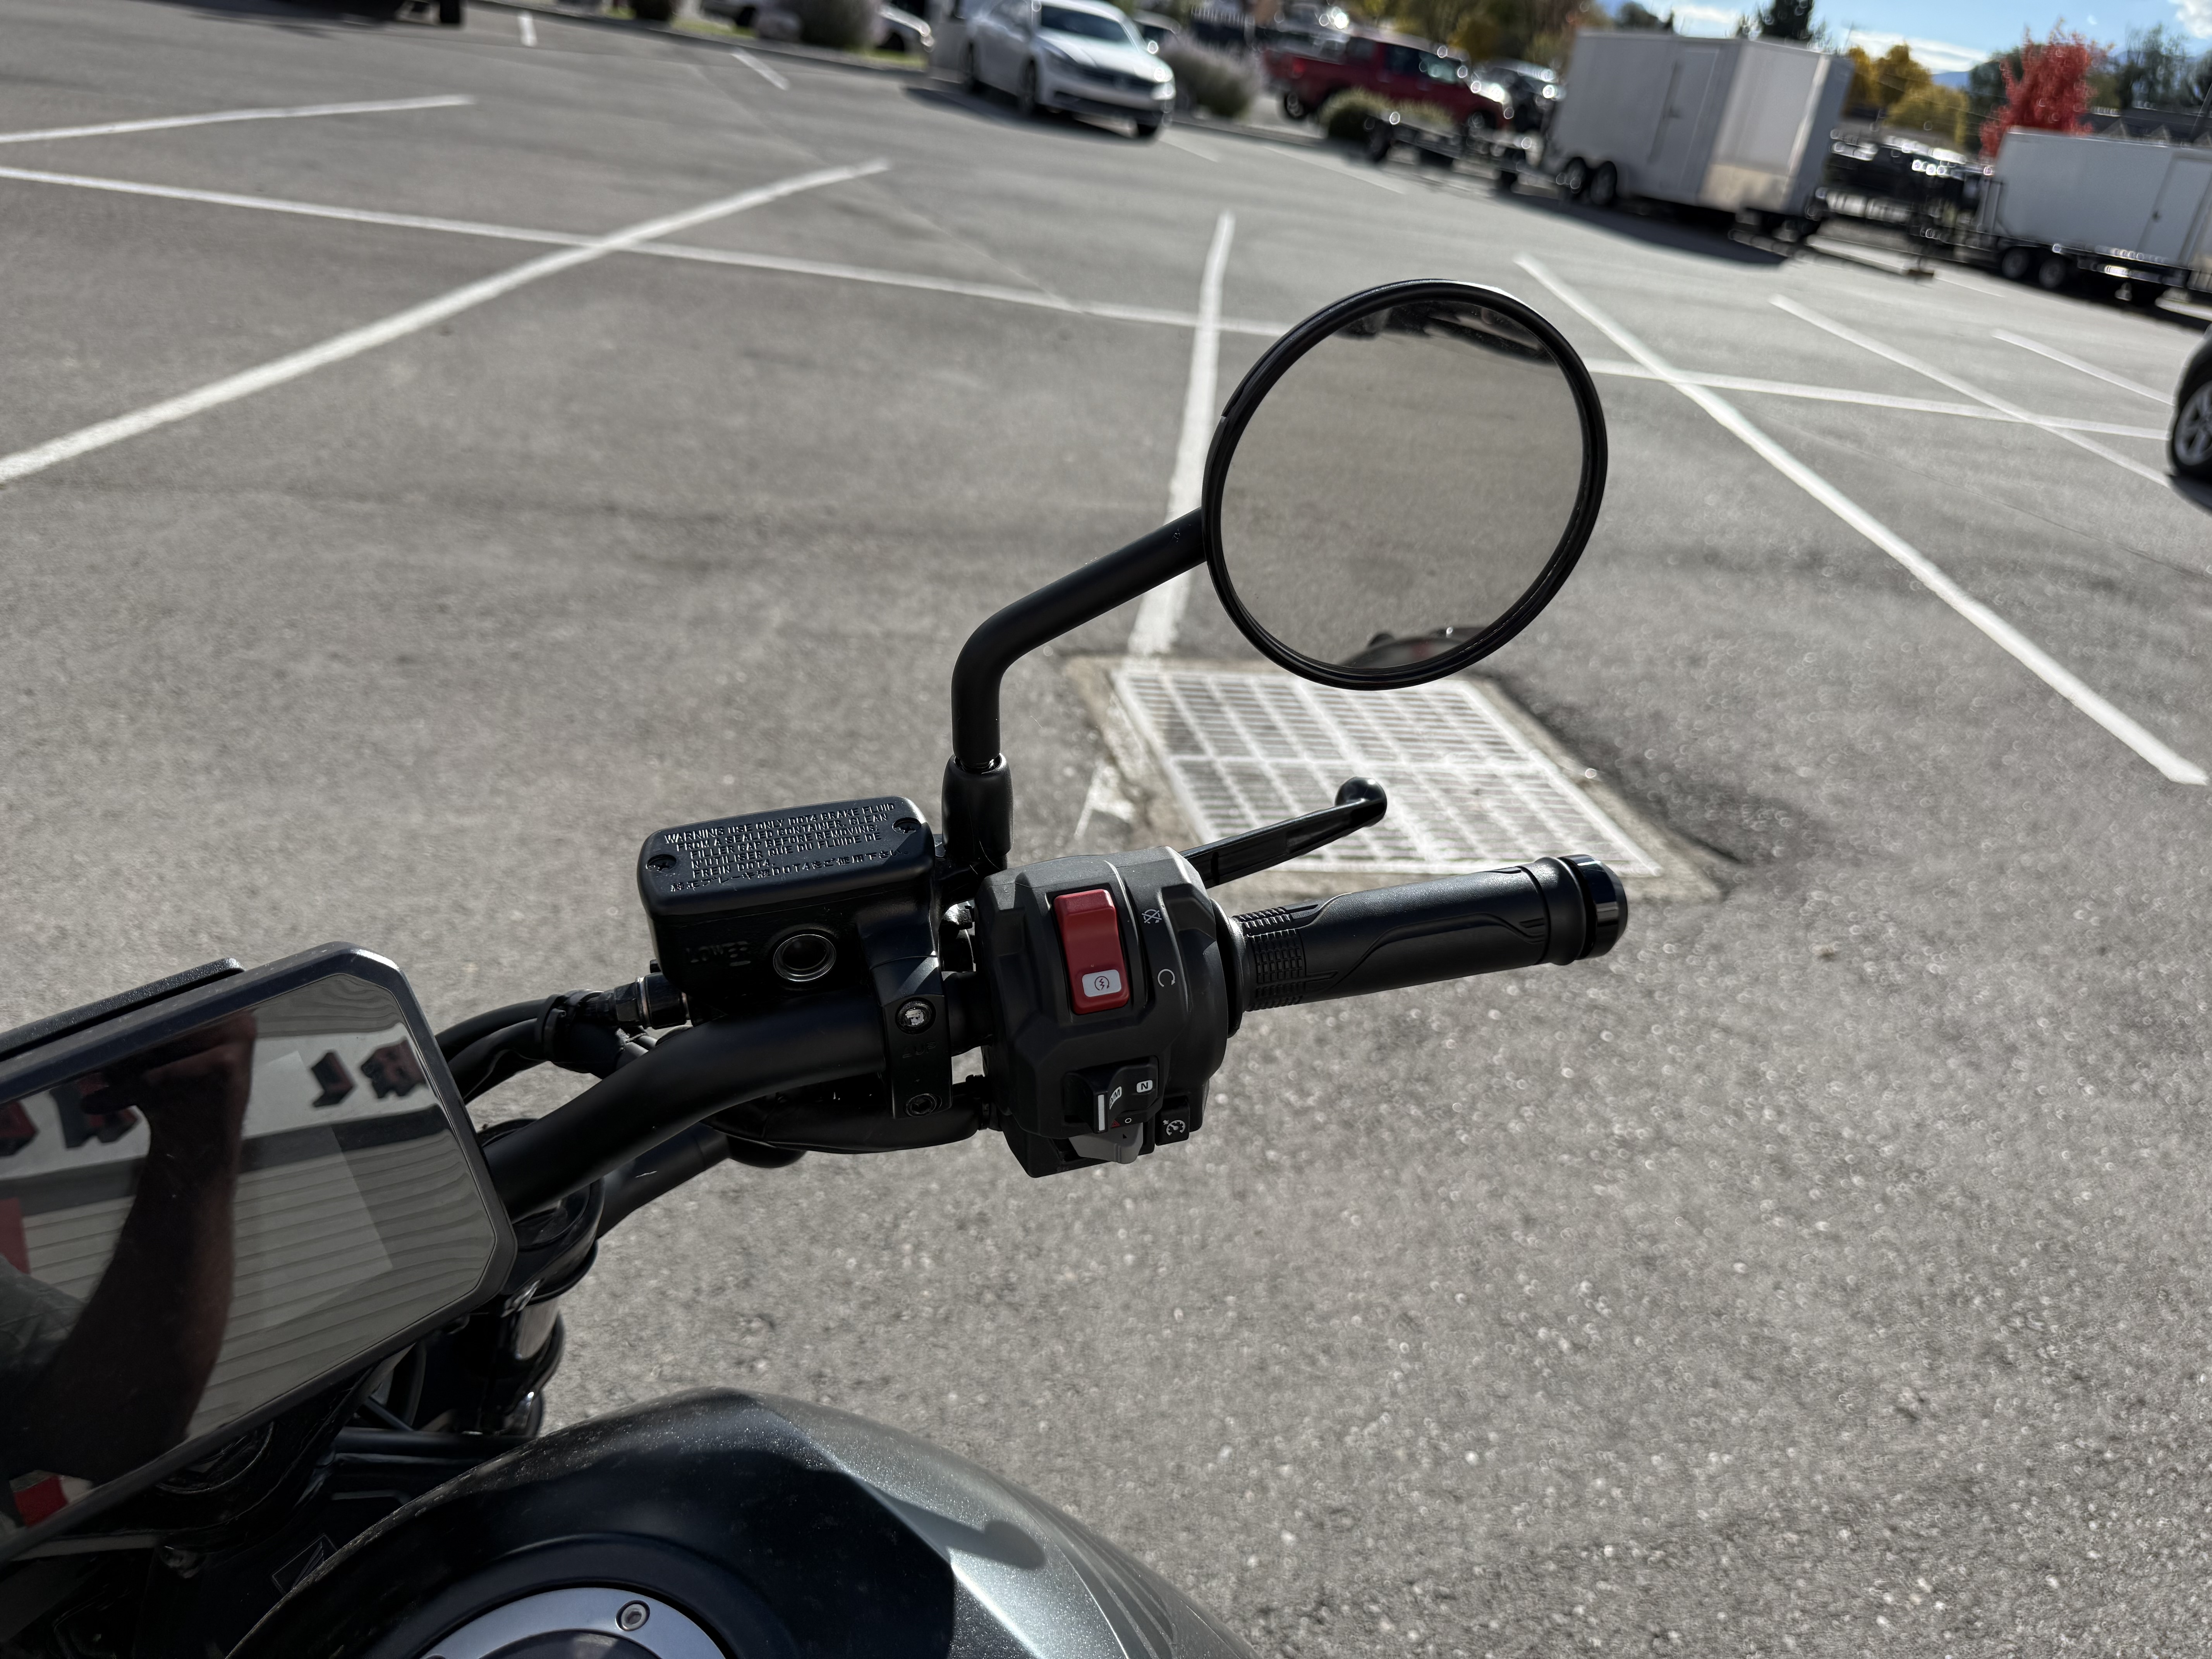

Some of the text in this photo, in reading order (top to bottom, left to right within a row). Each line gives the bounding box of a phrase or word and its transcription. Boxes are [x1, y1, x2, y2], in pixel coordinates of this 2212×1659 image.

[665, 803, 895, 843] WARNING USE ONLY DOT4 BRAKE FLUID
[677, 813, 888, 852] FROM A SEALED CONTAINER. CLEAN
[690, 845, 735, 859] FILLER
[738, 841, 762, 852] CAP
[765, 833, 813, 848] BEFORE
[691, 832, 882, 869] N'UTILISER QUE DU FLUIDE DE
[692, 858, 776, 879] FREIN DOT4.
[914, 1041, 936, 1055] UP
[1110, 1089, 1120, 1106] D/M
[1141, 1082, 1148, 1090] N
